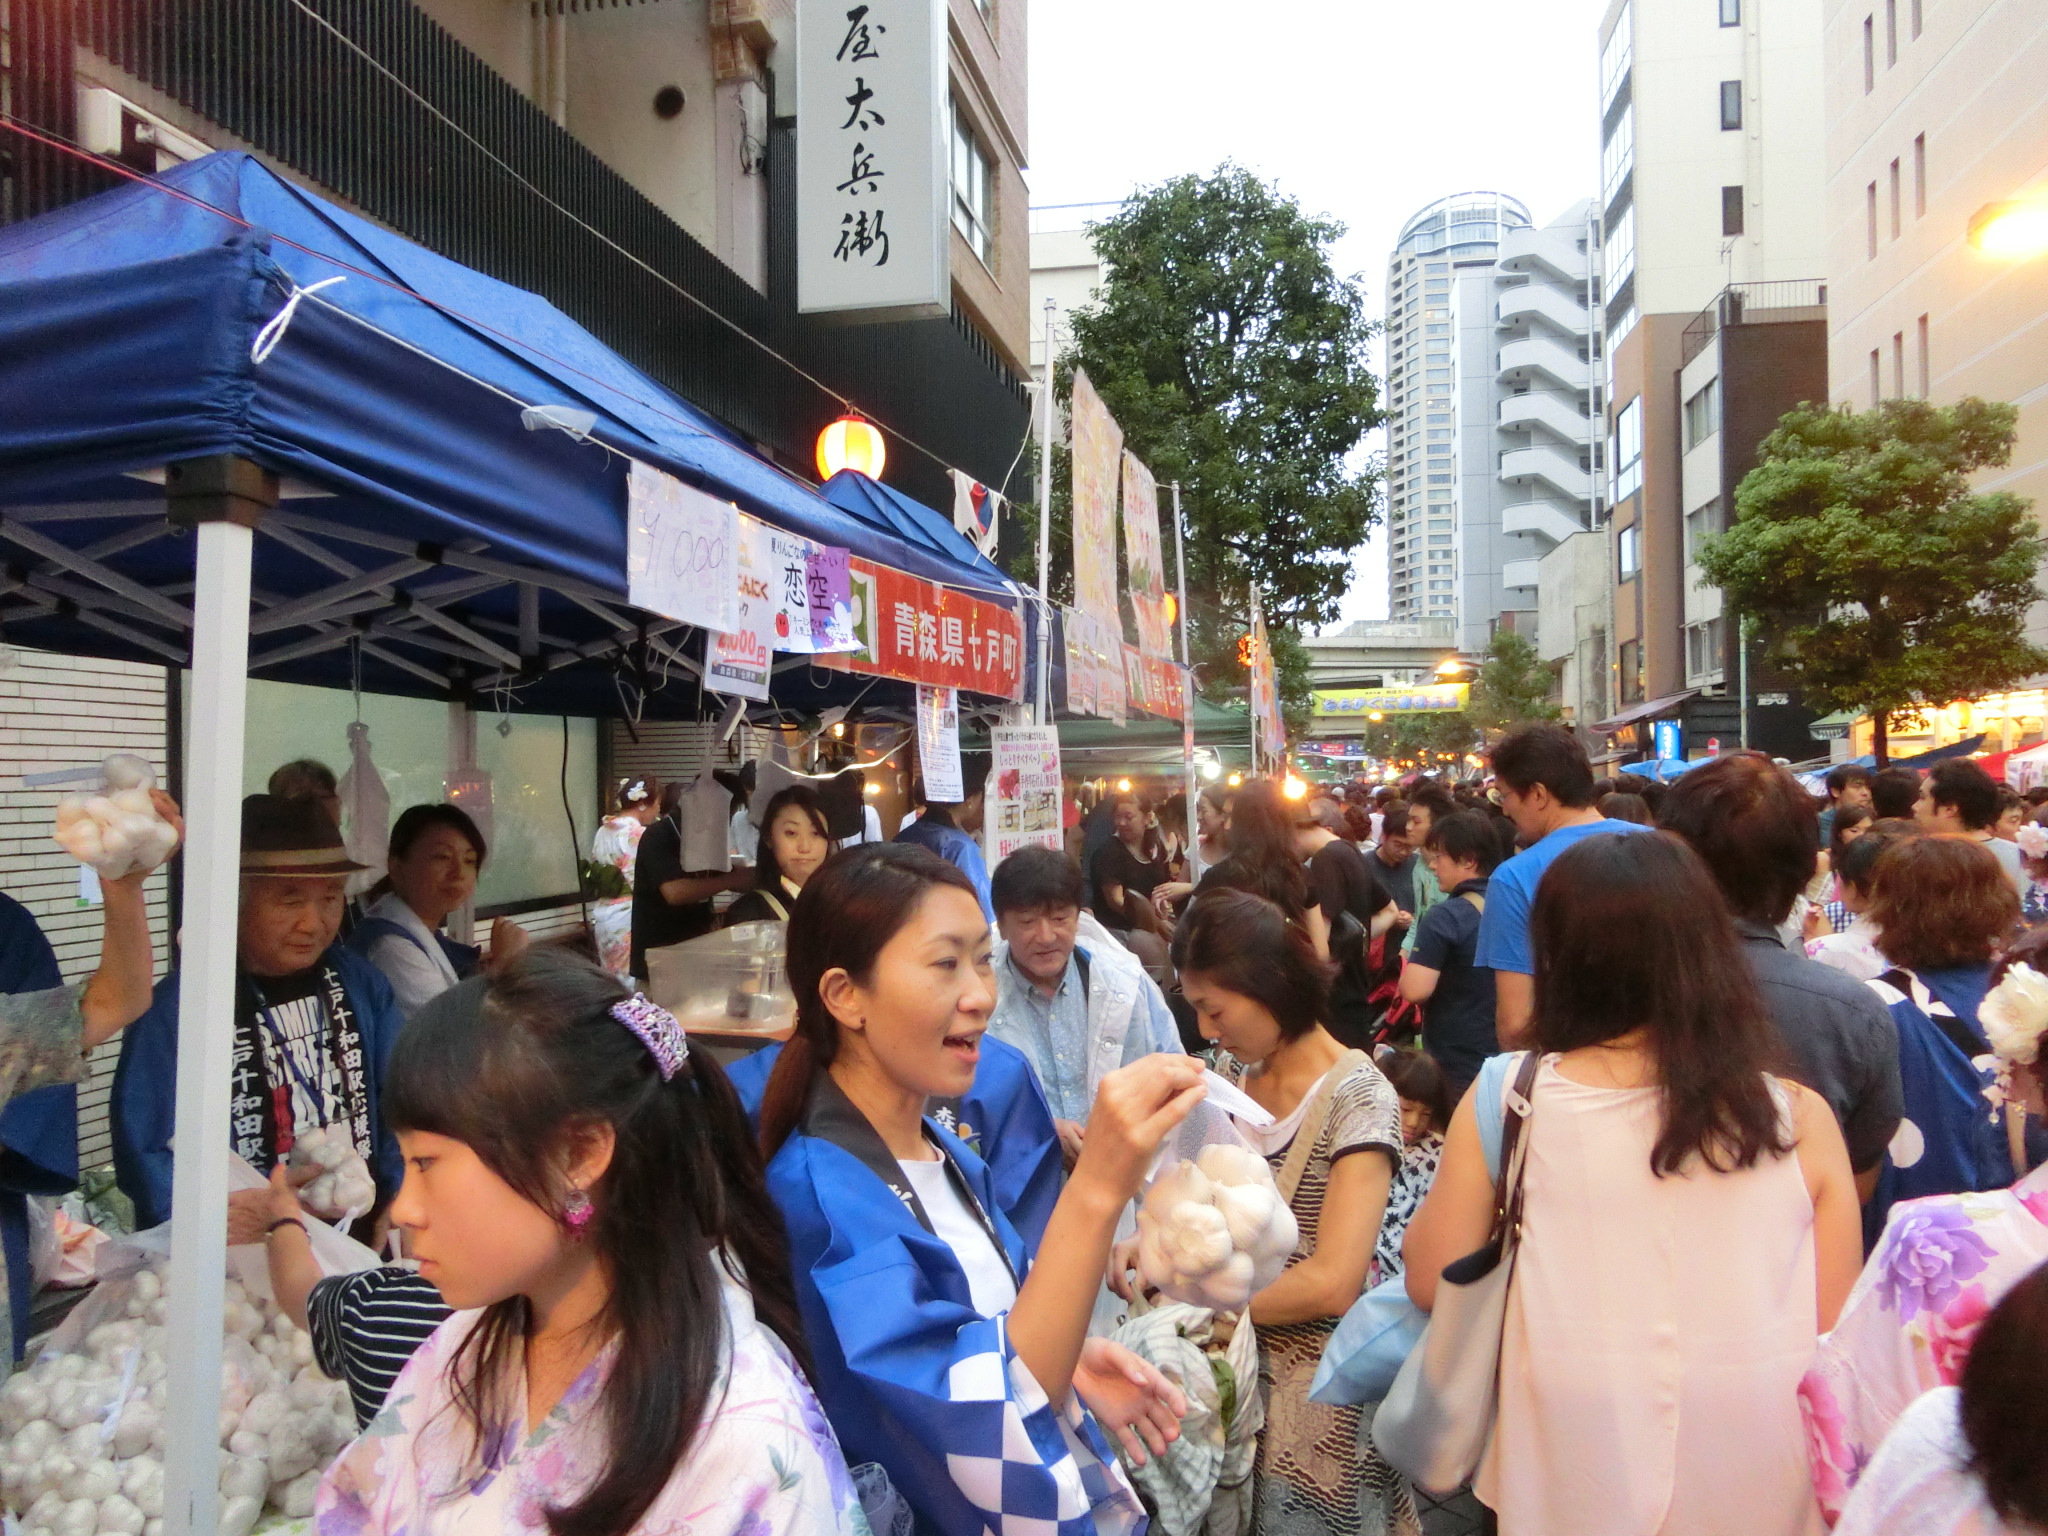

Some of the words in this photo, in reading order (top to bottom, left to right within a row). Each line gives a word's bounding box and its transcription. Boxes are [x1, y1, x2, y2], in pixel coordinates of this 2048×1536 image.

[784, 562, 831, 611] 恋空
[893, 601, 1018, 680] 青森県七戸町
[231, 1025, 269, 1168] 七戸十和田駅
